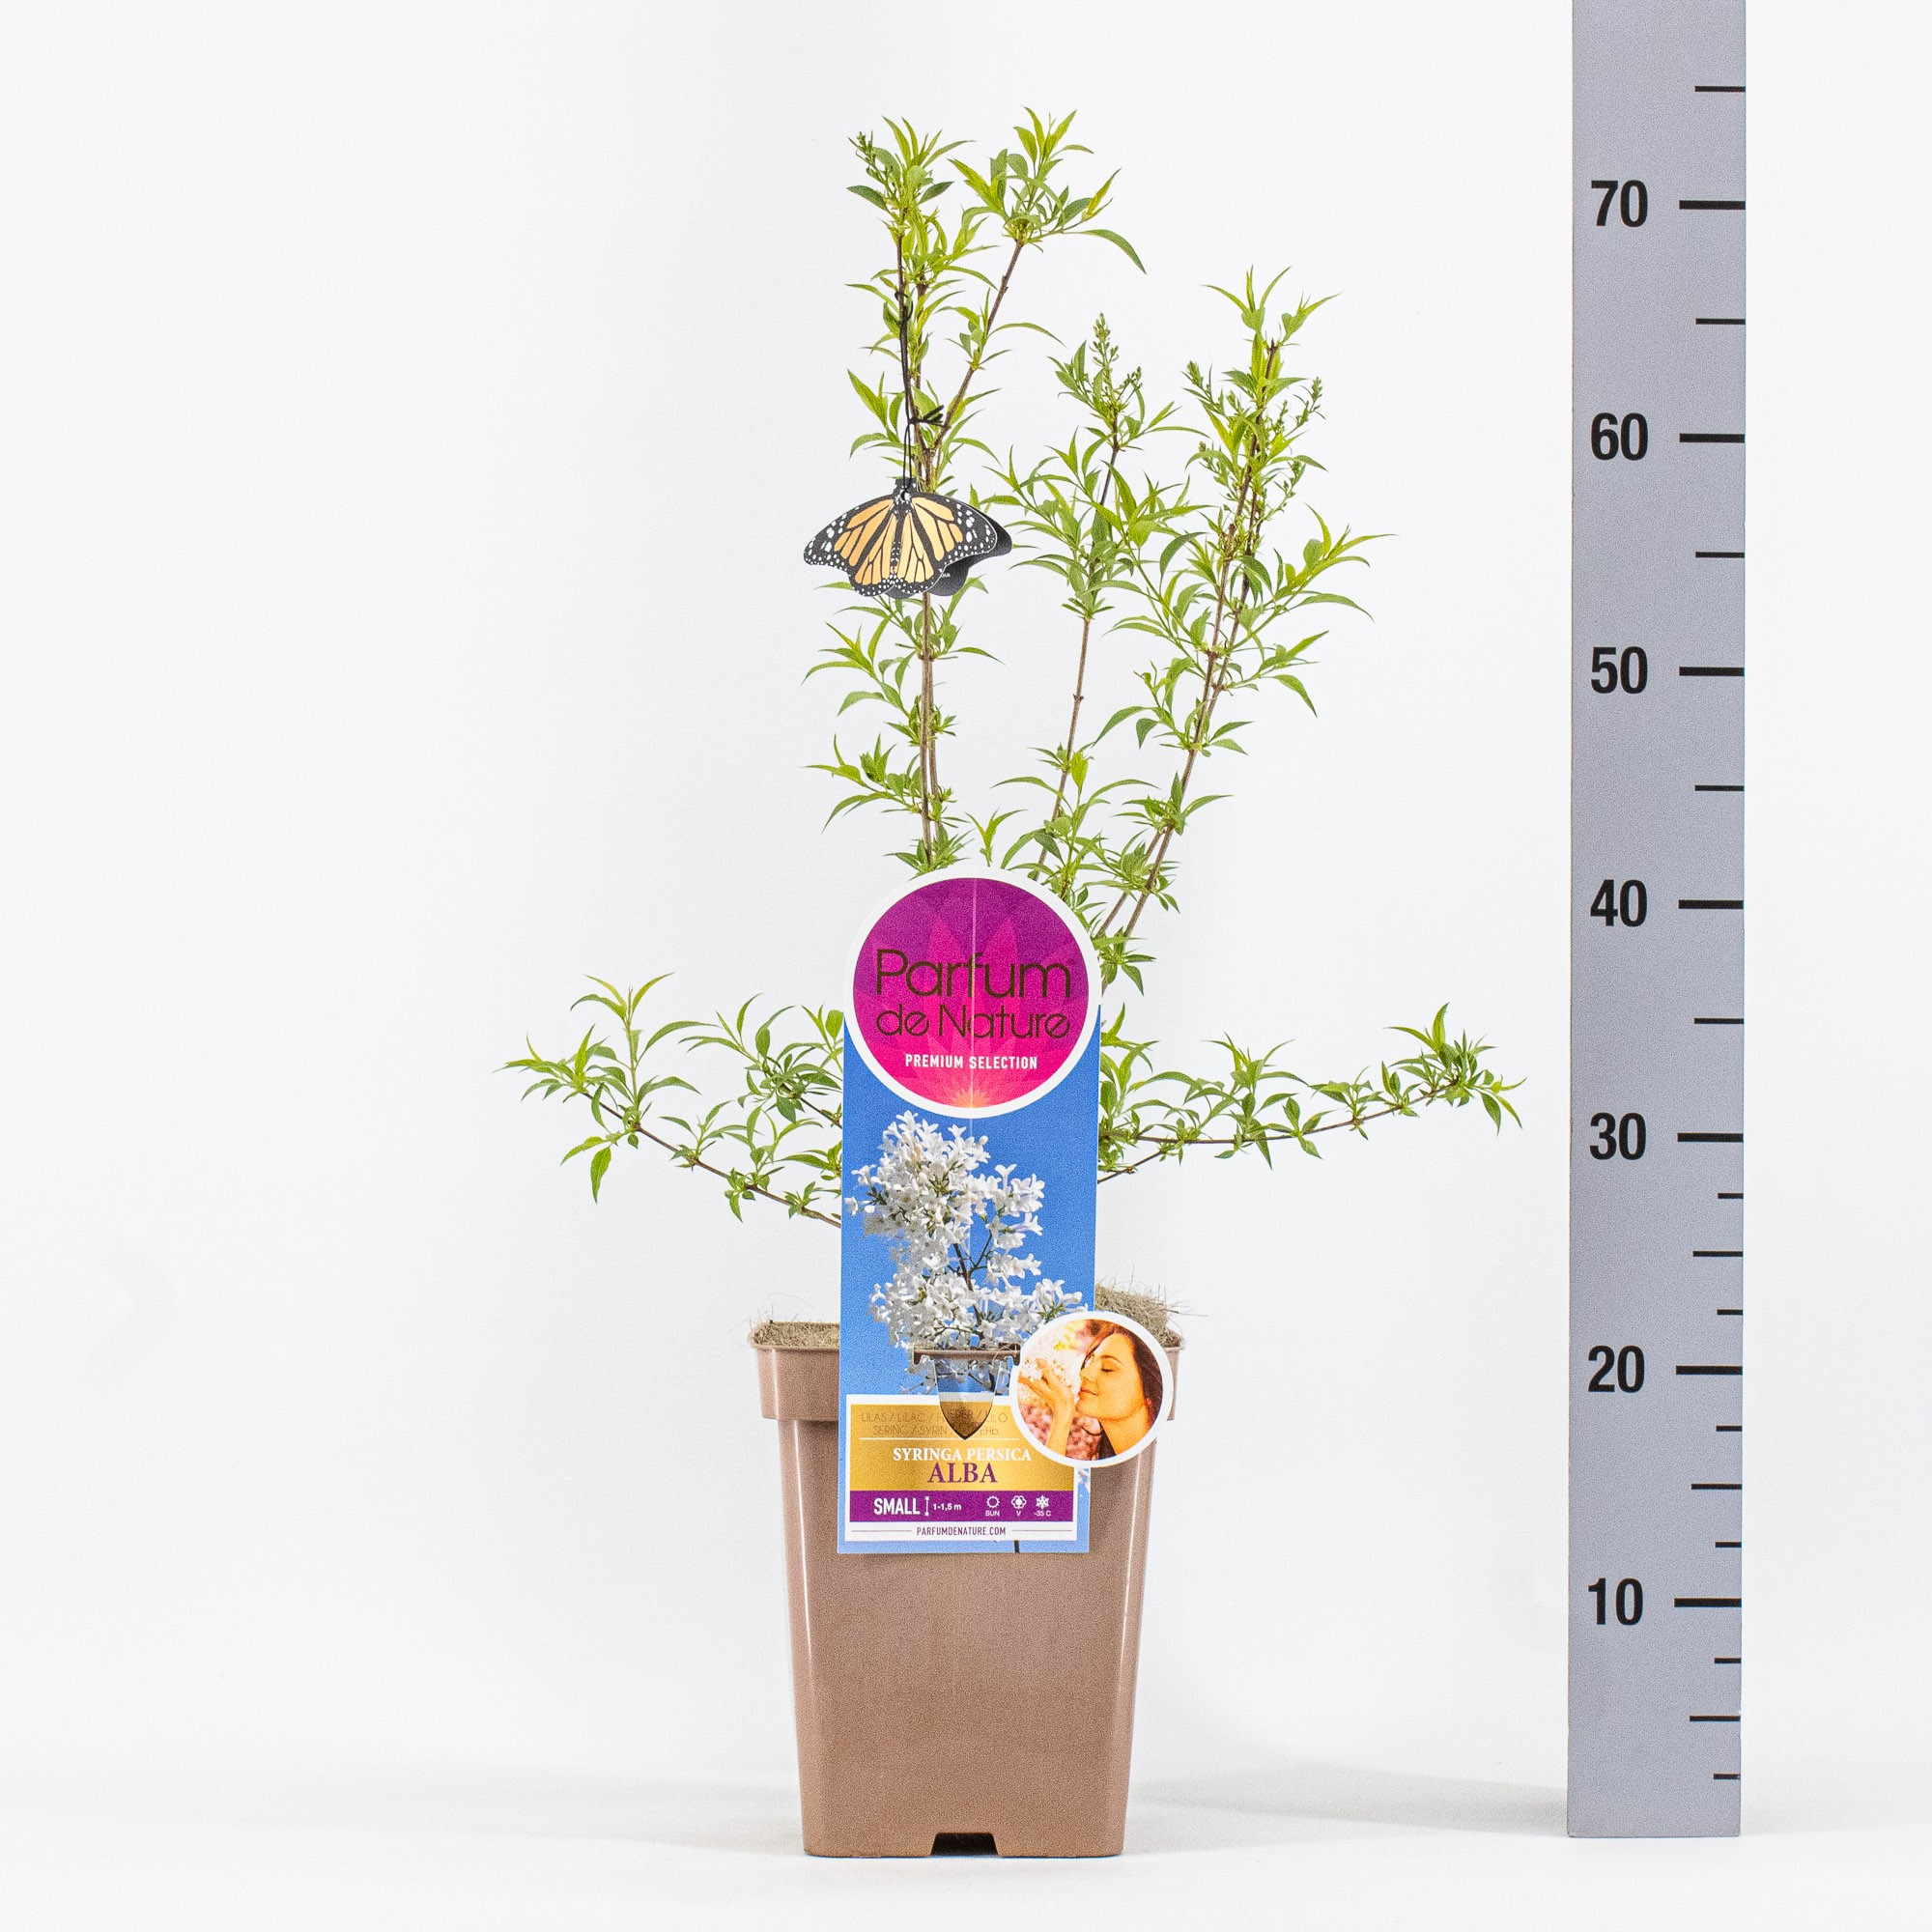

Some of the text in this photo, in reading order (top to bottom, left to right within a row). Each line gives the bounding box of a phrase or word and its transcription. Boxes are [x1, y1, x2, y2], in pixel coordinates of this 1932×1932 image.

[1591, 180, 1648, 227] 70
[1591, 412, 1648, 460] 60
[1591, 647, 1648, 694] 50
[1590, 880, 1647, 926] 40
[876, 949, 1071, 999] Parfum
[876, 1003, 1071, 1038] de Nature
[905, 1054, 1037, 1069] PREMIUM SELECTION
[1589, 1113, 1646, 1160] 30
[1588, 1346, 1644, 1393] 20
[893, 1447, 1032, 1462] SYRINGA PERSICA
[927, 1462, 998, 1483] ALBA
[873, 1497, 921, 1515] SMALL
[916, 1526, 1007, 1536] PARFUMDENATURE.COM
[1588, 1578, 1644, 1626] 10
